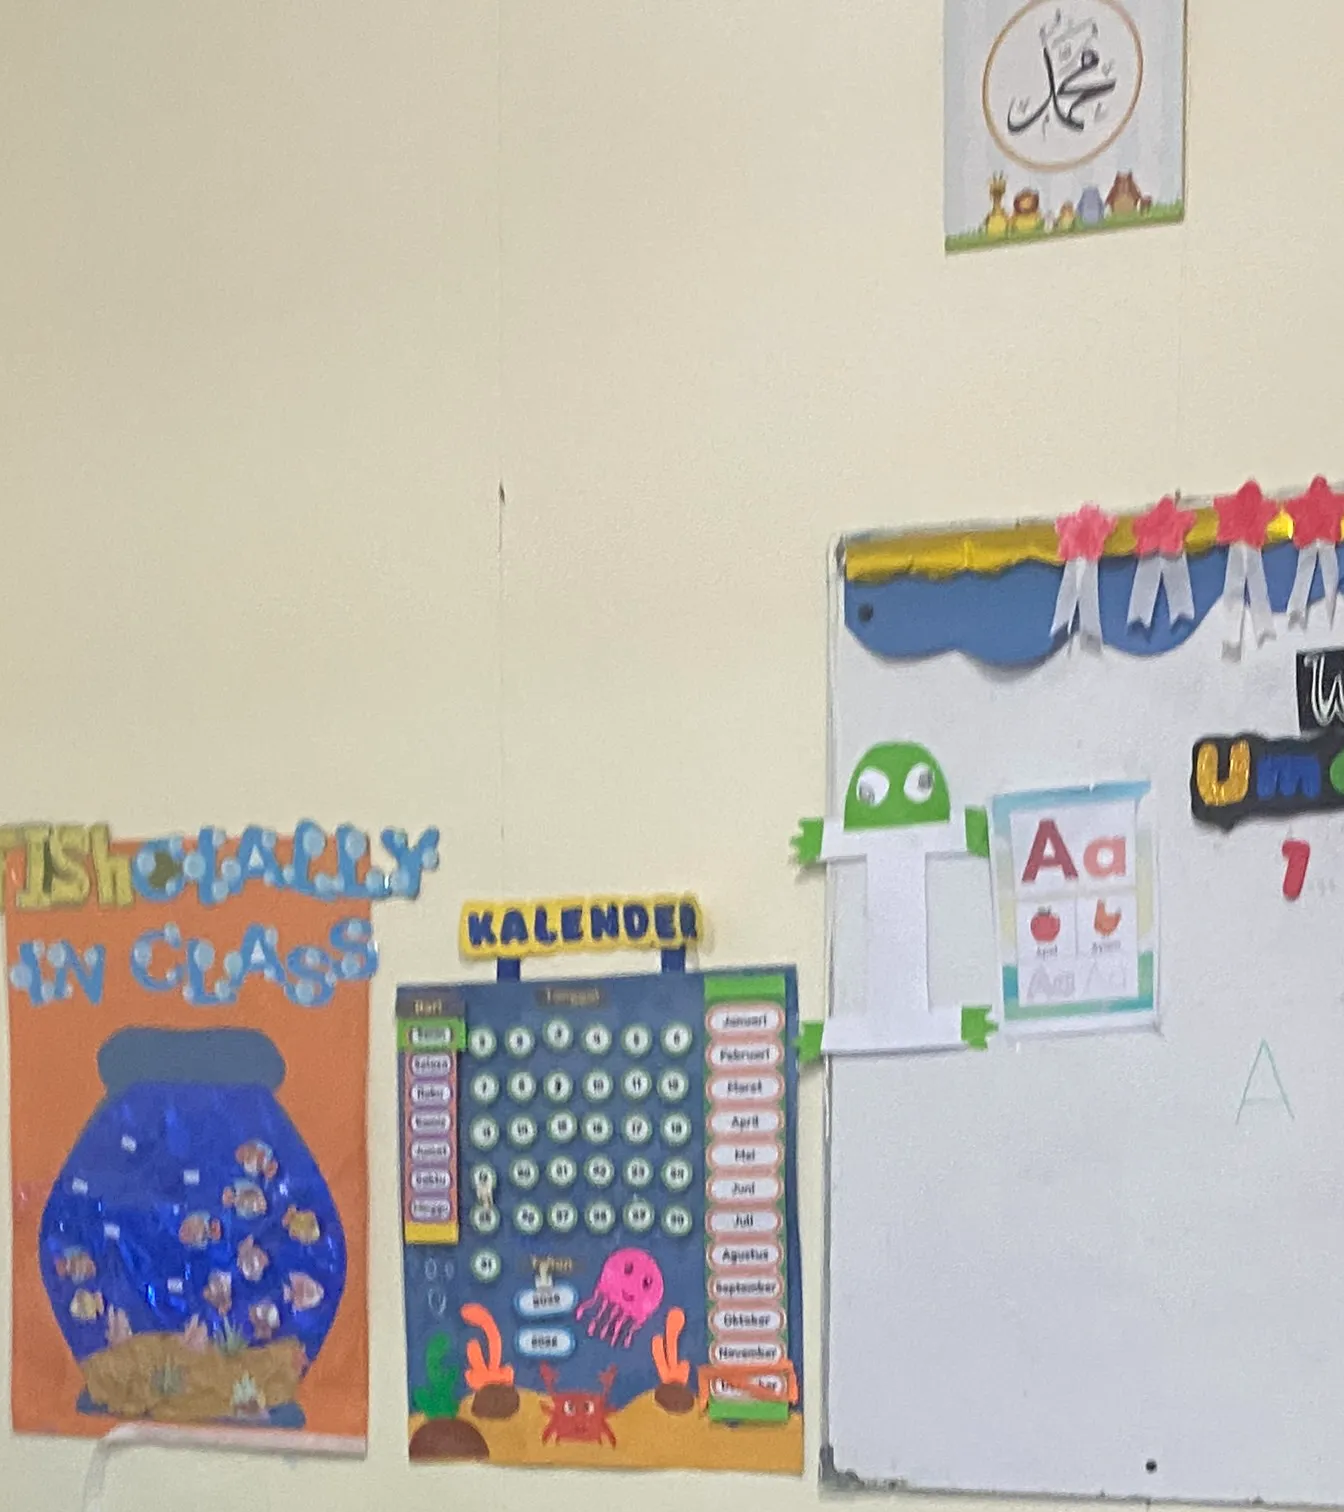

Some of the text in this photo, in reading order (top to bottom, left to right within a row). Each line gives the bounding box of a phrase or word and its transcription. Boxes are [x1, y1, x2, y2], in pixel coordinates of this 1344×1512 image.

[1021, 817, 1127, 884] Aa
[1281, 838, 1312, 902] 1
[10, 916, 380, 1007] IN CLASS
[1235, 1039, 1296, 1126] A
